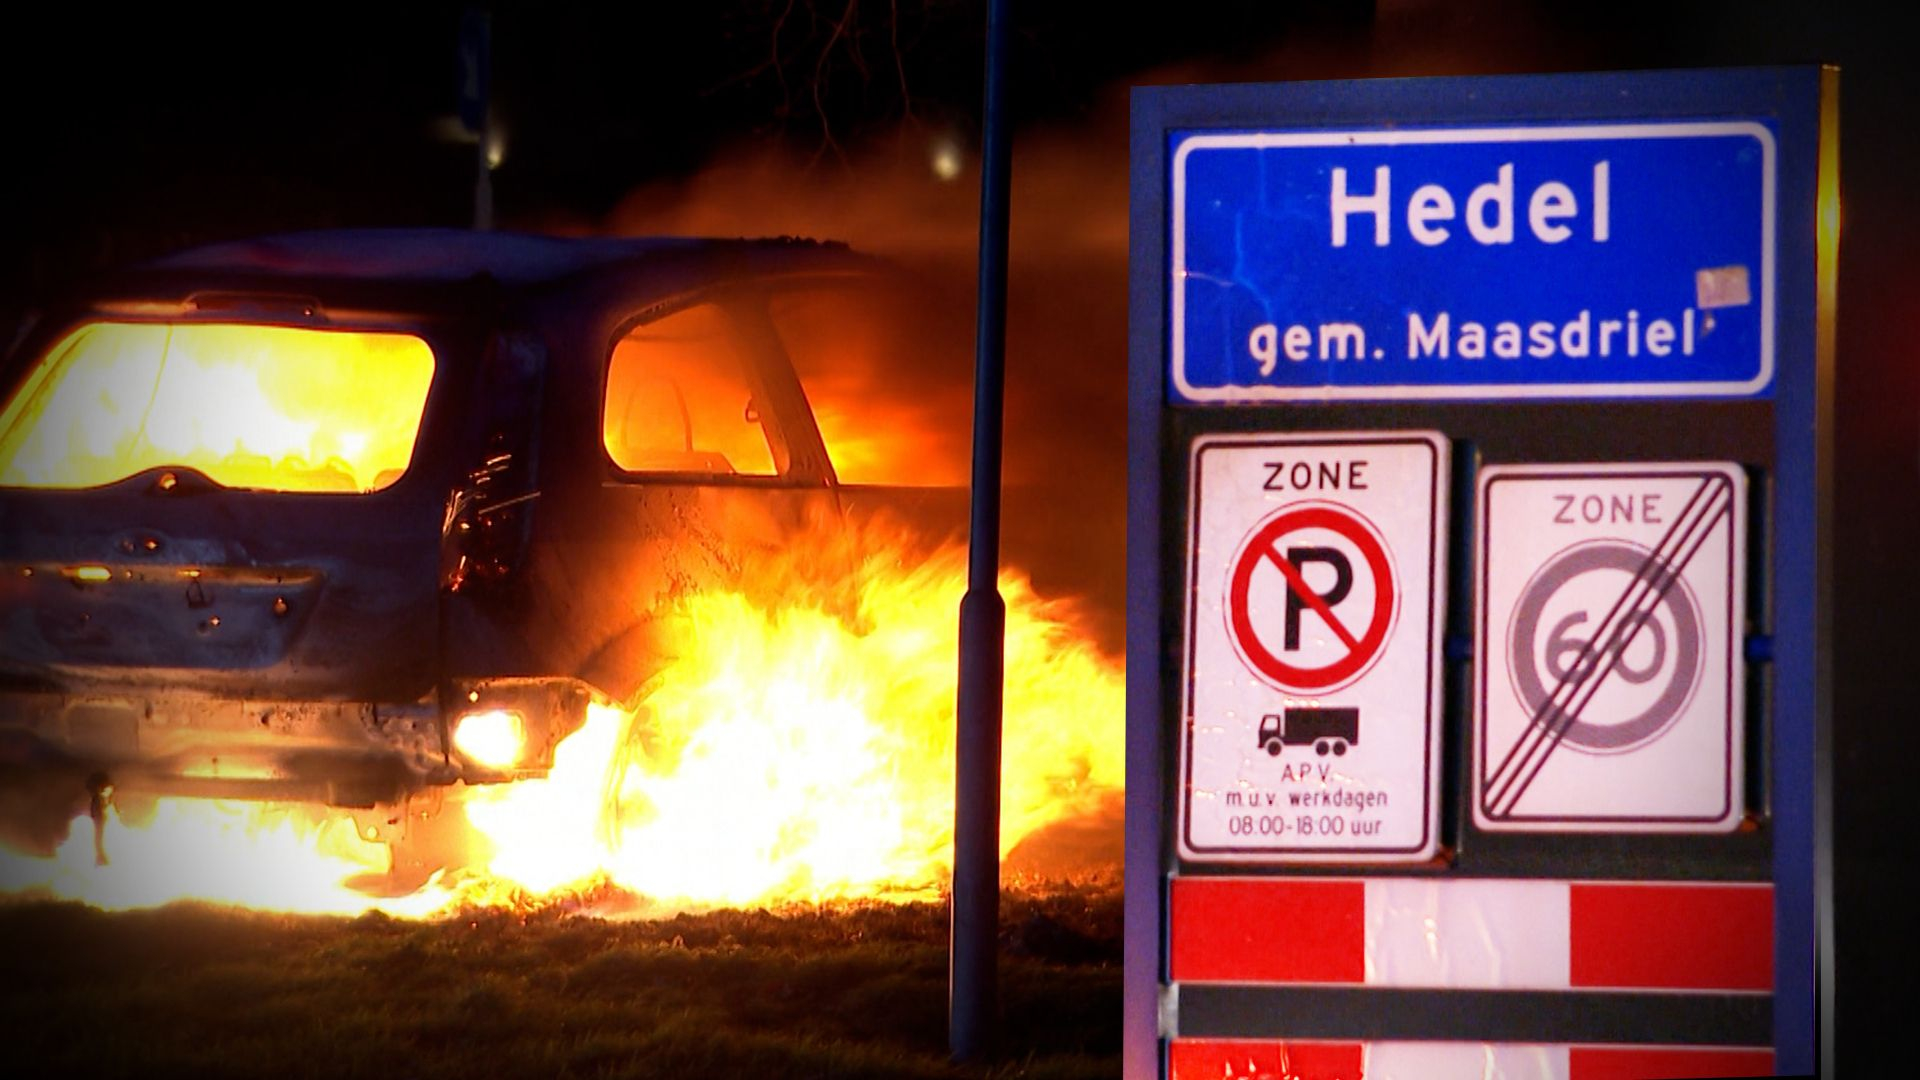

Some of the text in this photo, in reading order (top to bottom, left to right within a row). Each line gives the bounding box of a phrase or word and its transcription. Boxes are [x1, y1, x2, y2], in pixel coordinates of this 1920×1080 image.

[1331, 161, 1609, 247] Hedel
[1249, 309, 1694, 377] gem. Maasdriel
[1263, 461, 1369, 491] ZONE
[1553, 494, 1662, 524] ZONE
[1284, 546, 1353, 651] P
[1545, 610, 1666, 684] 60
[1289, 789, 1388, 812] werkdagen
[1351, 820, 1382, 835] uur
